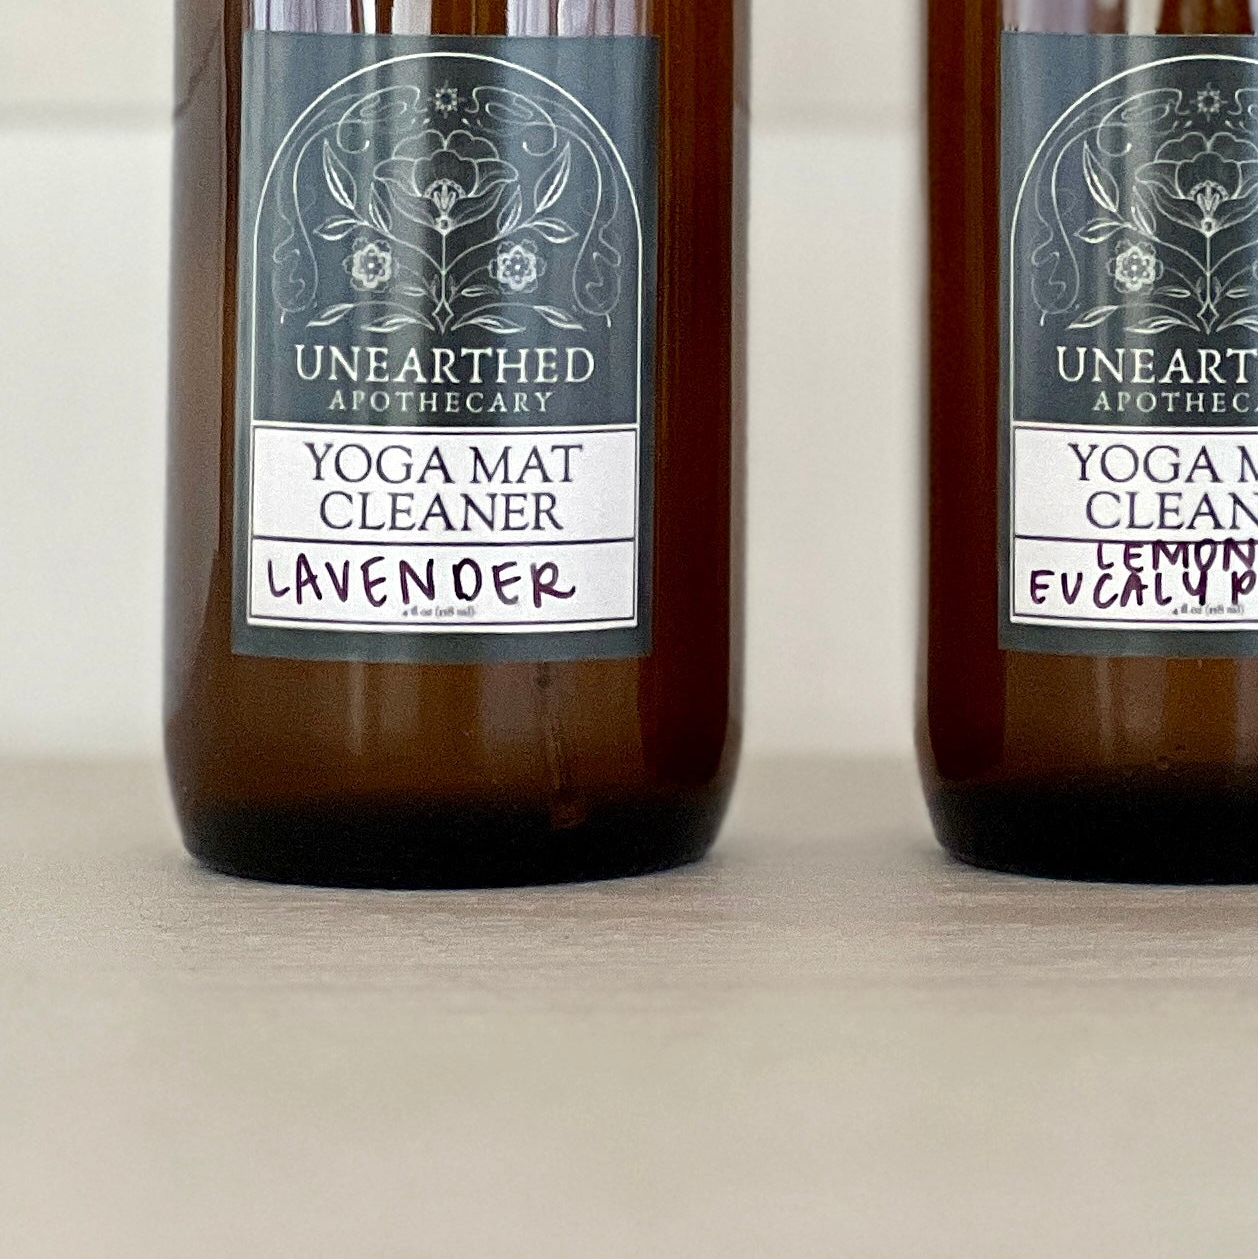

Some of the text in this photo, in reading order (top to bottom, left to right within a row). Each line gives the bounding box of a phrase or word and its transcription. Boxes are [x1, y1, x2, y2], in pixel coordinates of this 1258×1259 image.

[294, 344, 596, 384] UNEARTHED
[328, 389, 556, 413] APOTHECARY
[304, 441, 584, 484] YOGA MAT
[1068, 442, 1221, 484] YOGA
[319, 490, 564, 532] CLEANER
[1096, 537, 1257, 573] LEMON
[267, 552, 576, 609] LAVENDER
